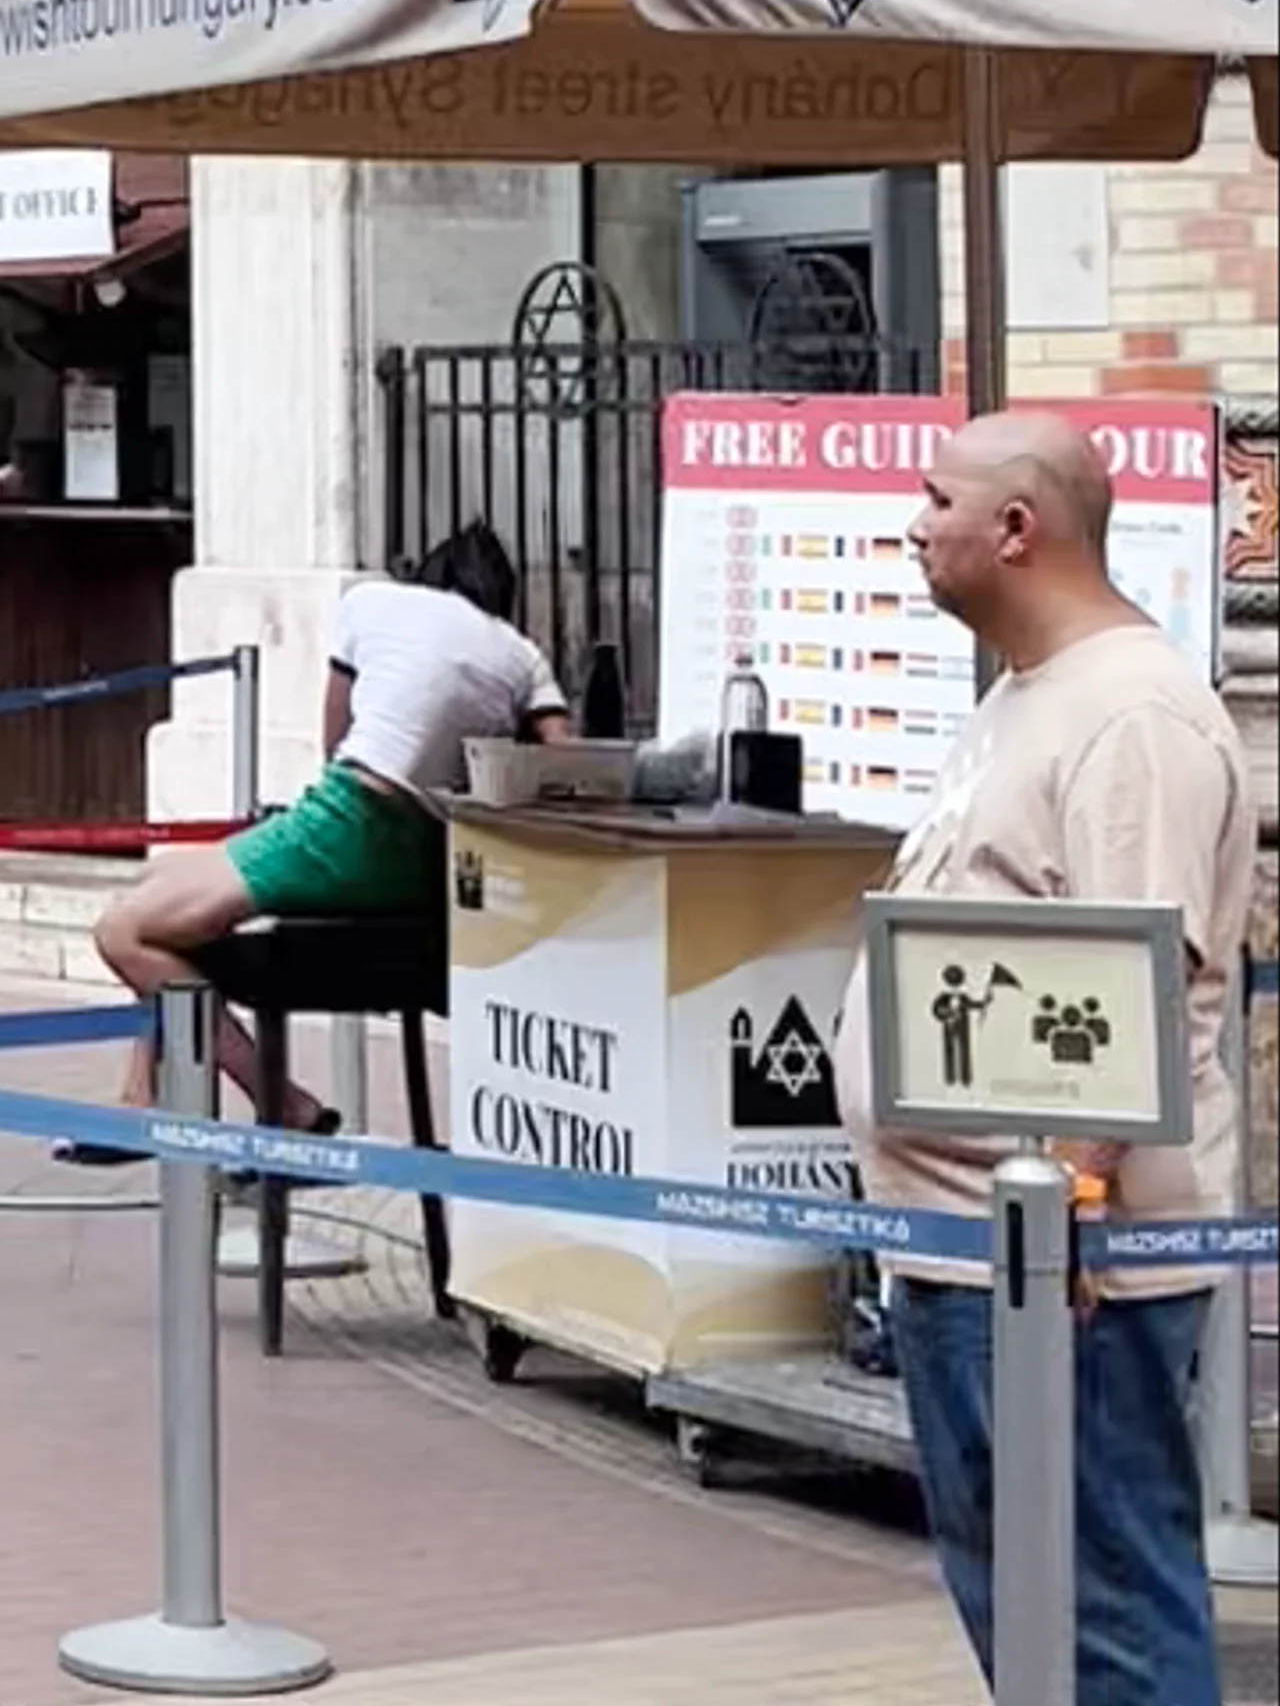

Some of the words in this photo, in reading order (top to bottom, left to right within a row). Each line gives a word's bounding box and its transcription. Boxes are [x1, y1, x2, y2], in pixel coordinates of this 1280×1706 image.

[11, 185, 97, 220] OFFICE
[680, 418, 807, 466] FREE
[822, 420, 954, 471] GUID
[1089, 424, 1209, 479] OUR
[485, 1000, 617, 1093] TICKET
[471, 1085, 634, 1177] CONTROL
